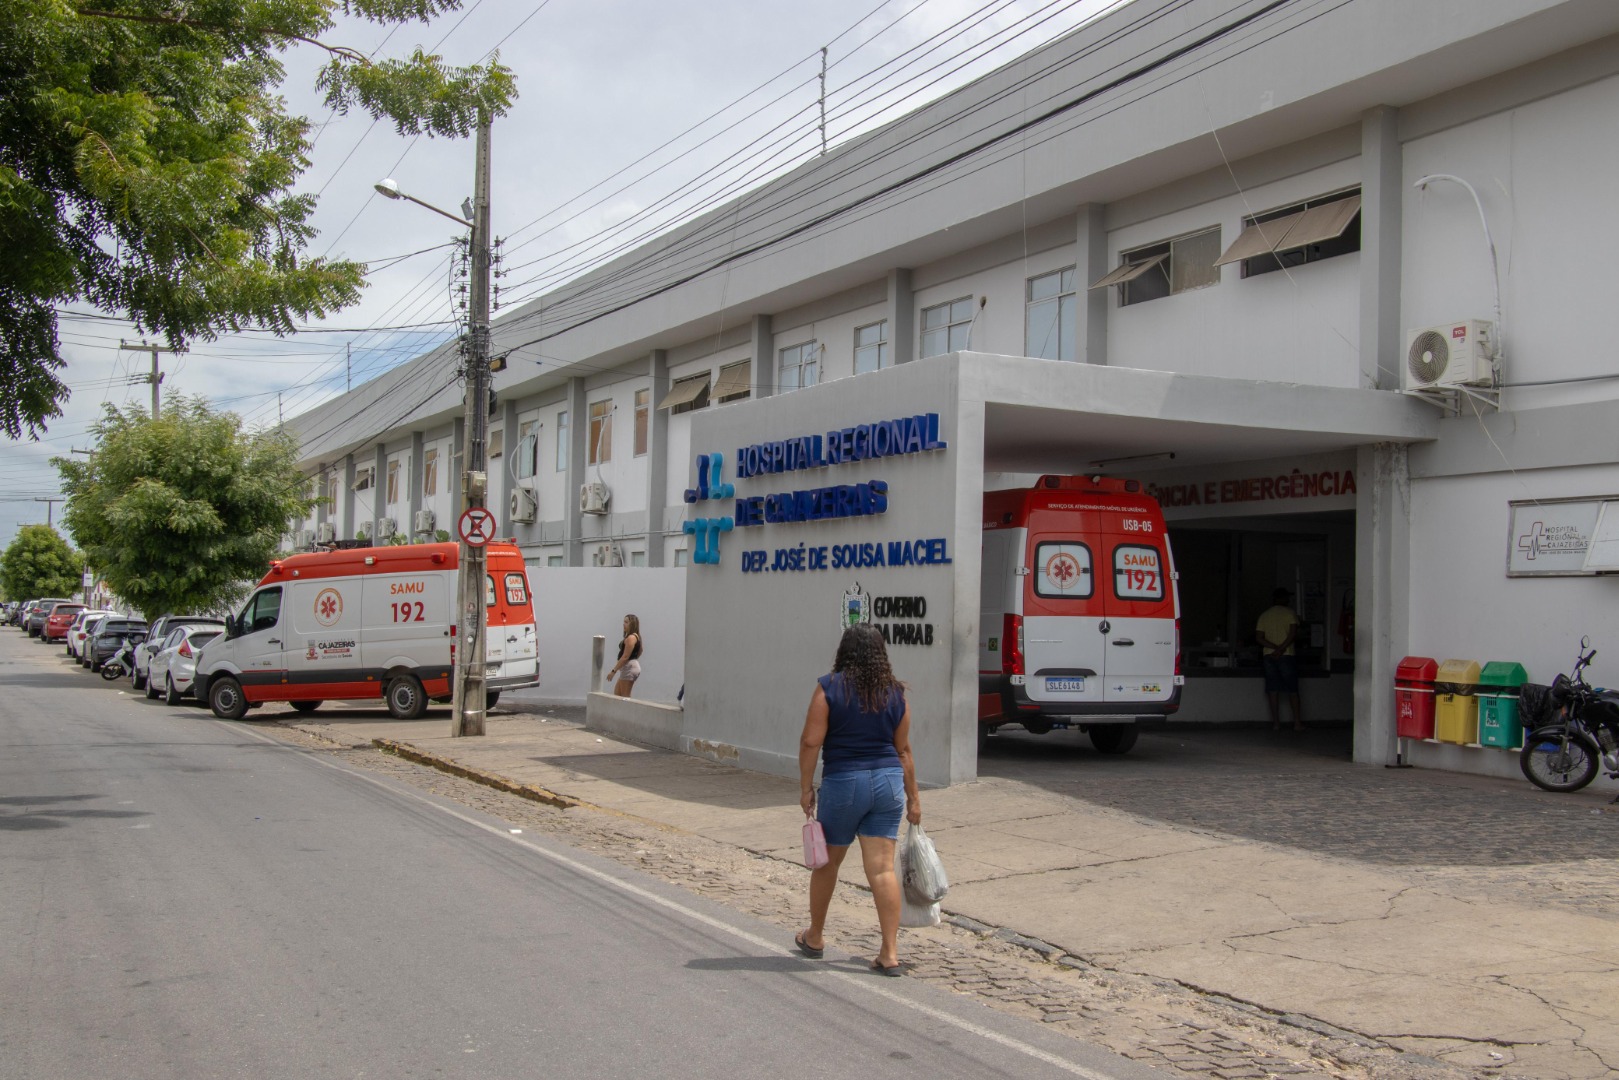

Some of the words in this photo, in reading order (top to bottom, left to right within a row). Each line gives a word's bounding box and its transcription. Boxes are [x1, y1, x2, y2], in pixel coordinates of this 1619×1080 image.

[736, 435, 829, 478] HOSPITAL
[827, 413, 948, 464] REGIONAL
[1204, 482, 1217, 505] E
[1220, 468, 1357, 503] EMERGÊNCIA
[735, 496, 765, 526] DE
[1123, 519, 1152, 532] USB-05
[1545, 526, 1578, 534] HOSPITAL
[741, 551, 769, 573] DEP.
[771, 542, 805, 571] JOSÉ
[808, 546, 828, 570] DE
[831, 542, 885, 568] SOUSA
[1124, 554, 1157, 567] SAMU
[390, 582, 424, 594] SAMU
[1124, 568, 1157, 591] 192
[510, 589, 524, 601] 192
[391, 601, 425, 622] 192
[874, 596, 927, 619] GOVERNO
[318, 641, 355, 649] CAJAZEIRAS
